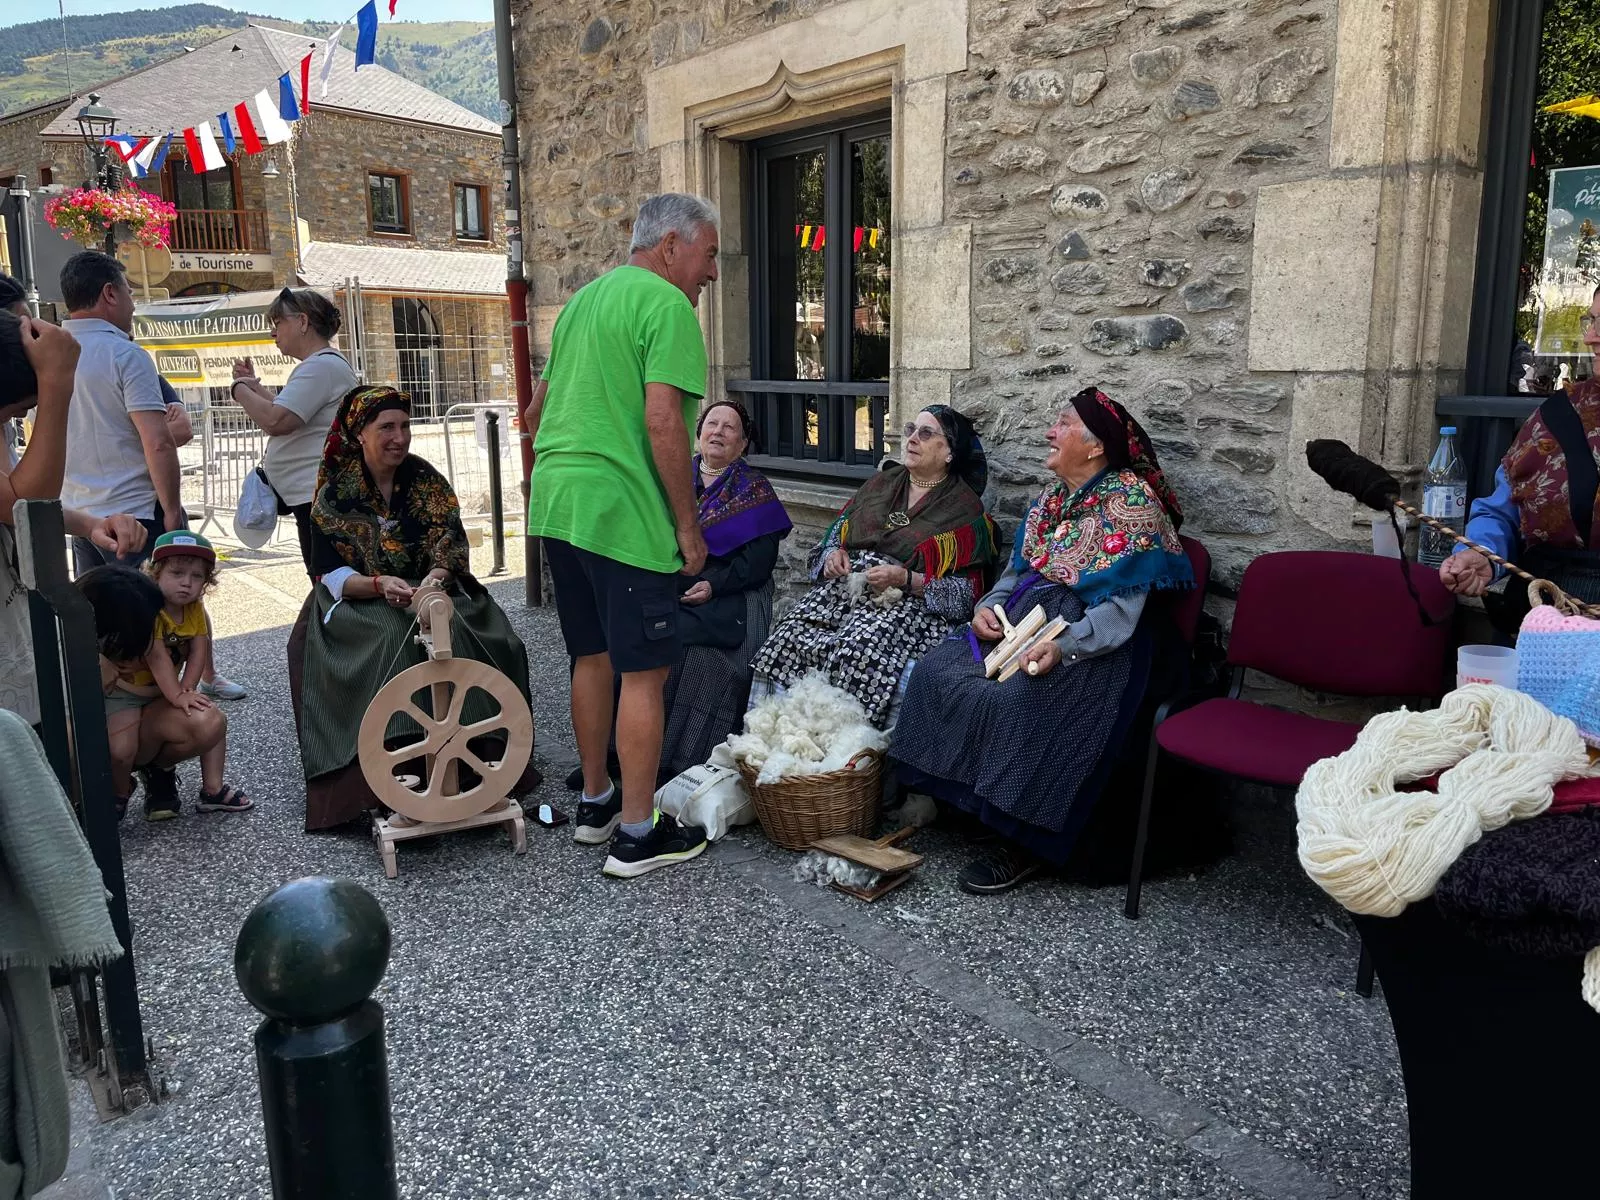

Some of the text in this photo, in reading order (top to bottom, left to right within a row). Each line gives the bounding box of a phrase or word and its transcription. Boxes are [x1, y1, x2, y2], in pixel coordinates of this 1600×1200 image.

[180, 257, 191, 269] de
[195, 256, 254, 270] Tourisme
[146, 320, 182, 337] MAISON
[184, 318, 200, 335] DU
[160, 356, 198, 371] OUVERTE
[253, 354, 297, 367] TRAVAUX
